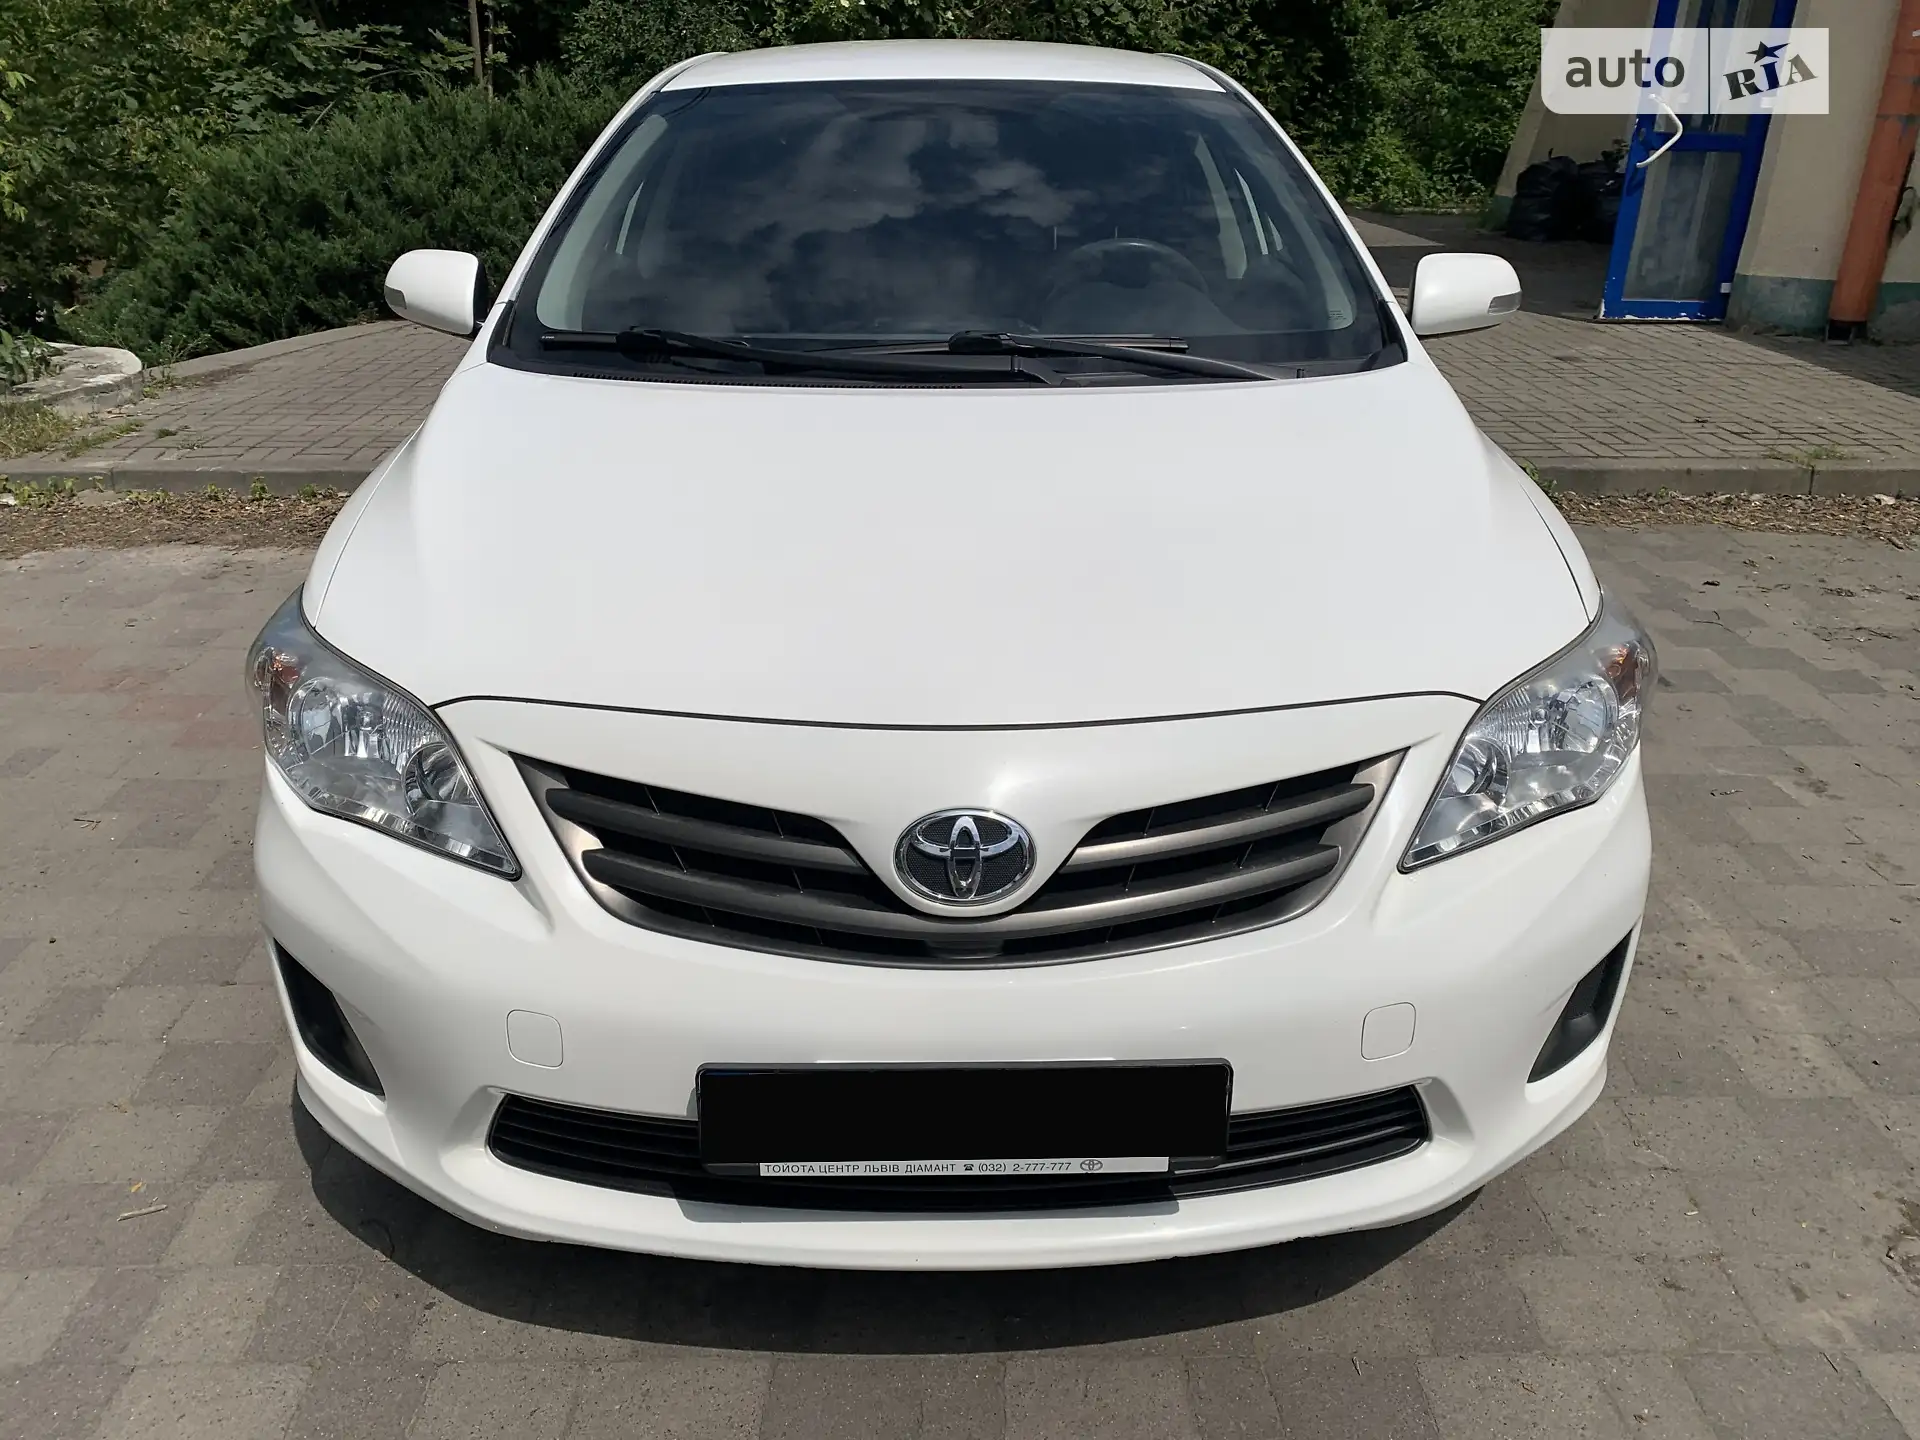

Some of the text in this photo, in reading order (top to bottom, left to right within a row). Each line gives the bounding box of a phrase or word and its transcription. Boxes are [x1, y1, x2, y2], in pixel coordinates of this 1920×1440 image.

[764, 1162, 1072, 1174] ТОЙОТА ЦЕНТР ЛЬВІВ ДІАМАНТ (032) 2-777-777
